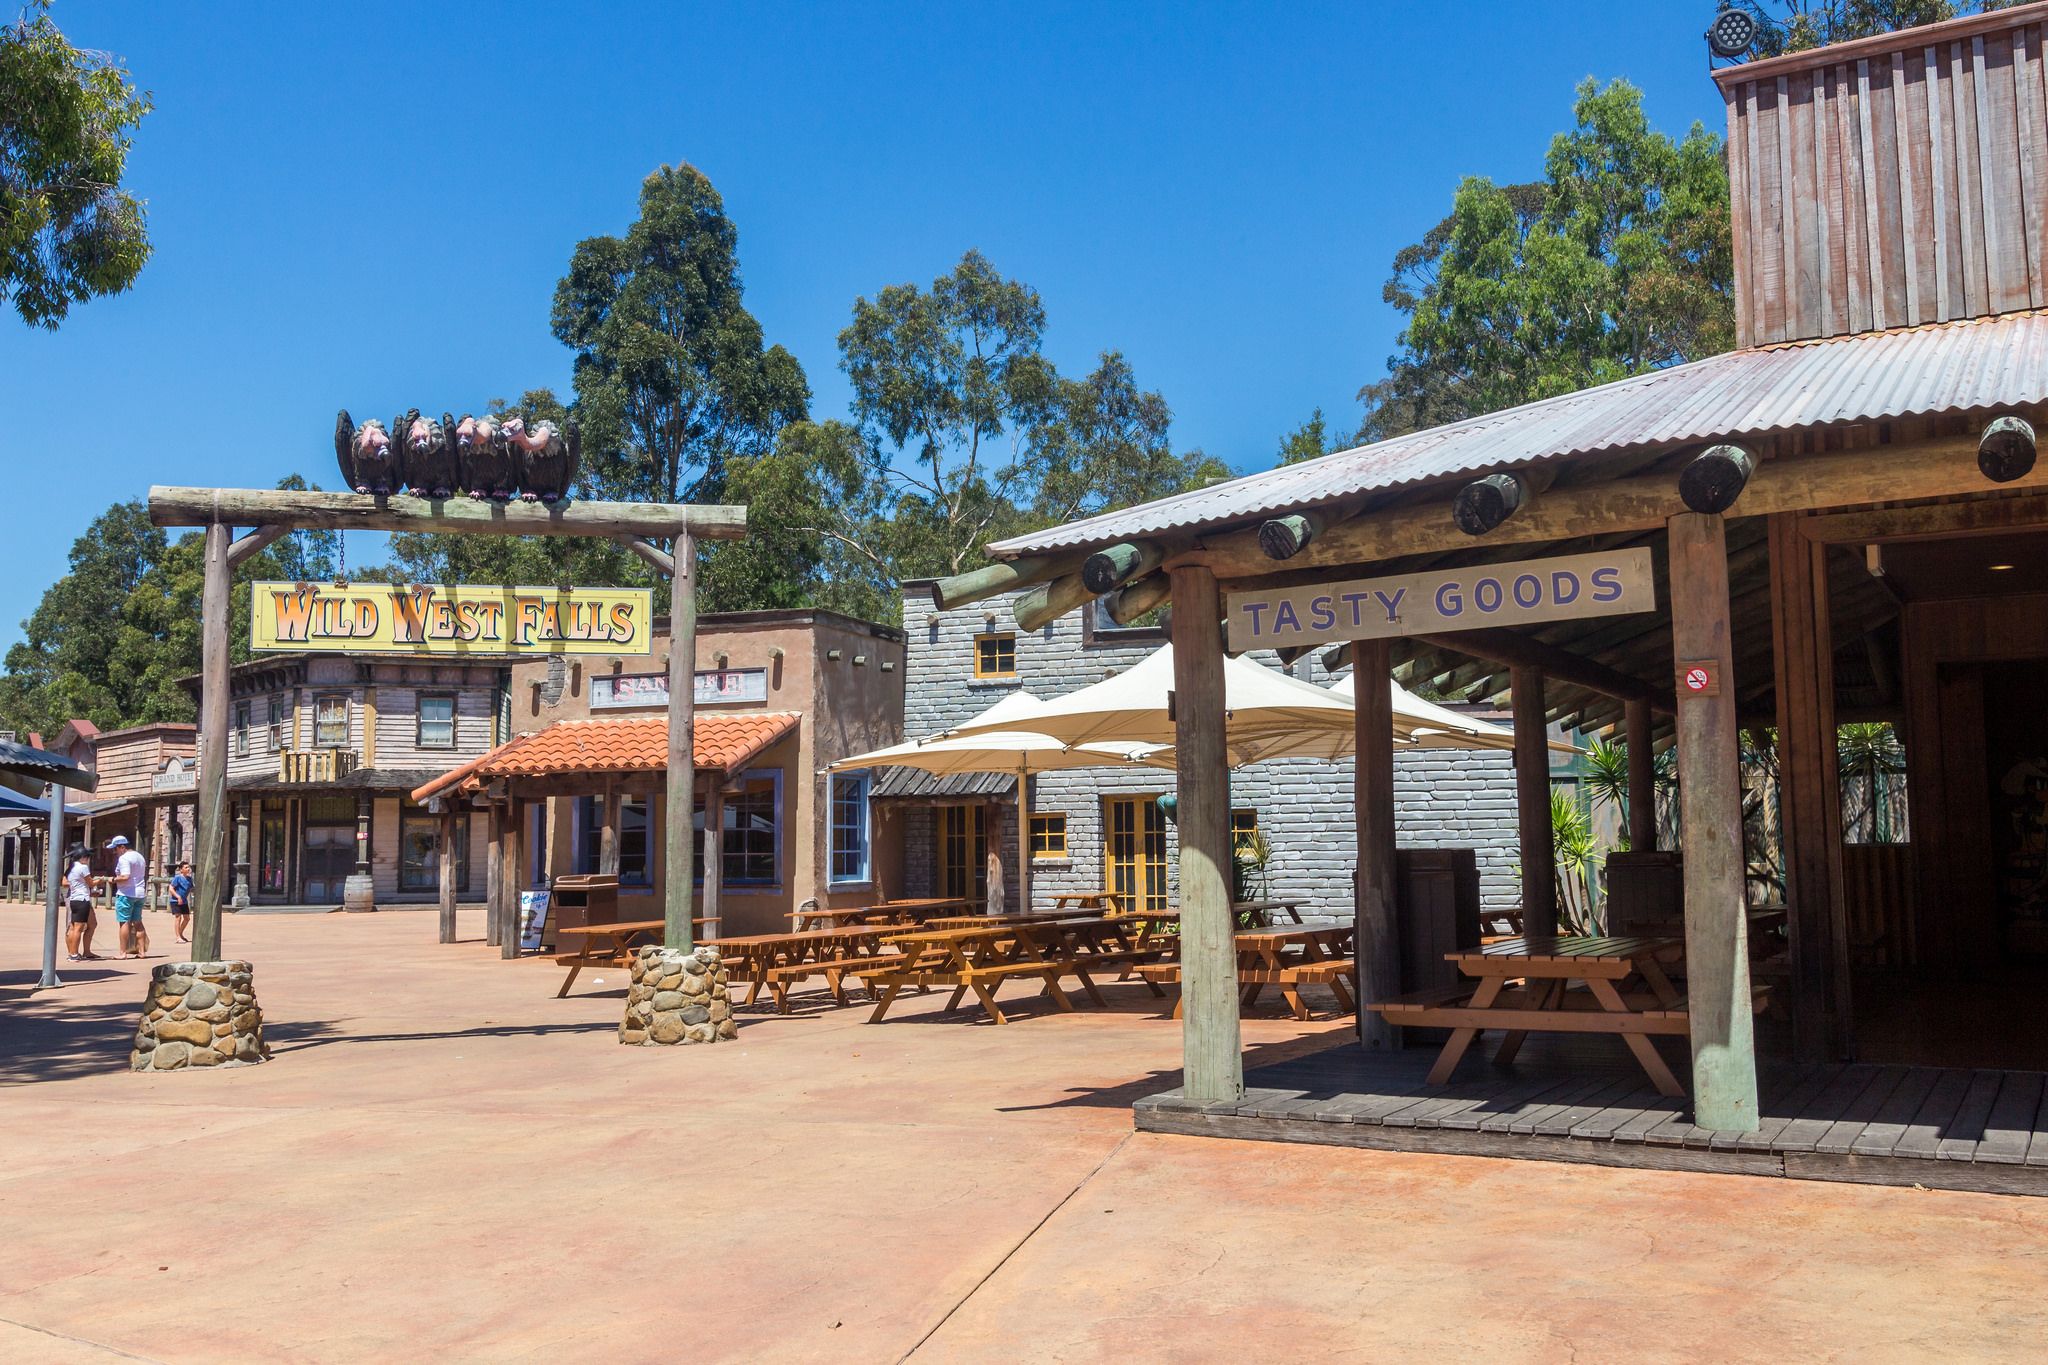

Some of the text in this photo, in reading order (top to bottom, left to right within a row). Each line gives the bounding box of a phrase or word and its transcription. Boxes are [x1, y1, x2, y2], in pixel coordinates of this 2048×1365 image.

[271, 581, 635, 646] WILD WEST FALLS
[1242, 566, 1624, 636] TASTY GOODS
